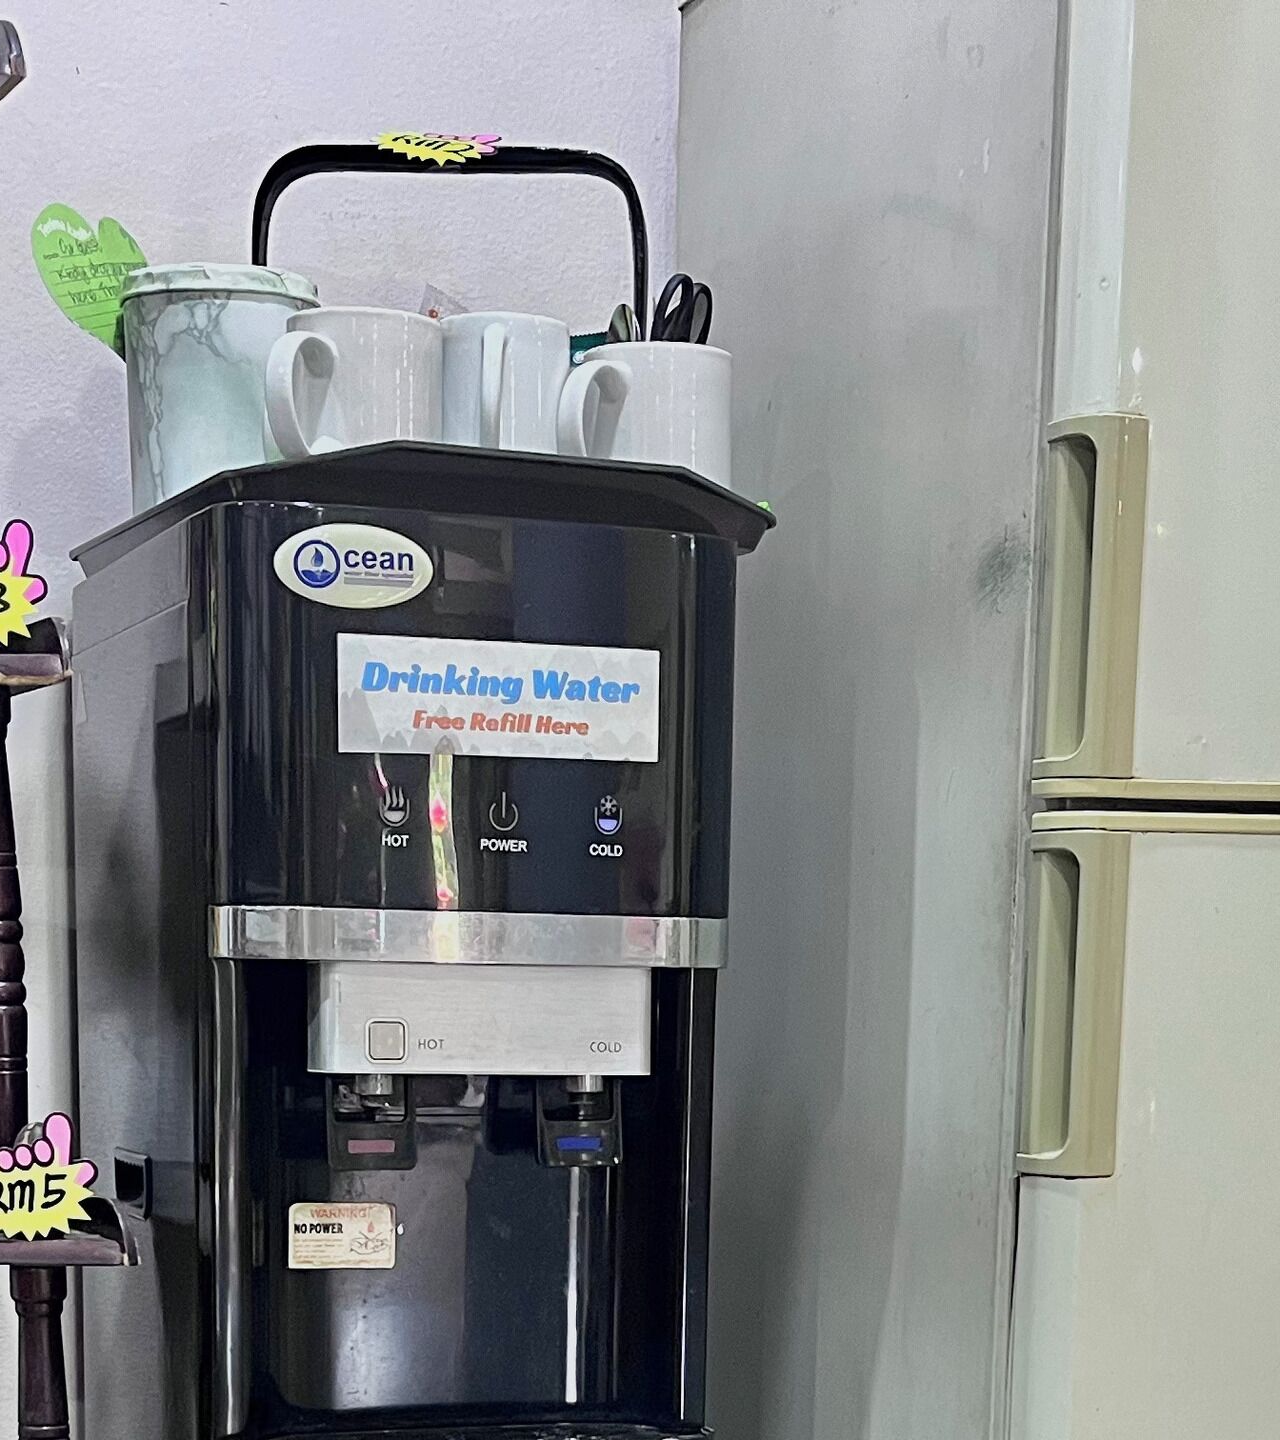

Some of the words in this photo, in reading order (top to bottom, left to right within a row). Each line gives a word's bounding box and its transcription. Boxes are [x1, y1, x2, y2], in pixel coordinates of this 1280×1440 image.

[362, 662, 523, 704] Drinking
[532, 670, 640, 703] Water
[412, 710, 465, 731] Free
[470, 712, 531, 734] Refill
[535, 715, 589, 736] Here
[381, 834, 409, 848] HOT
[480, 838, 528, 853] POWER
[589, 844, 623, 858] COLD
[417, 1038, 445, 1050] HOT
[589, 1040, 622, 1053] COLD
[294, 1223, 307, 1234] NO
[309, 1223, 343, 1234] POWER
